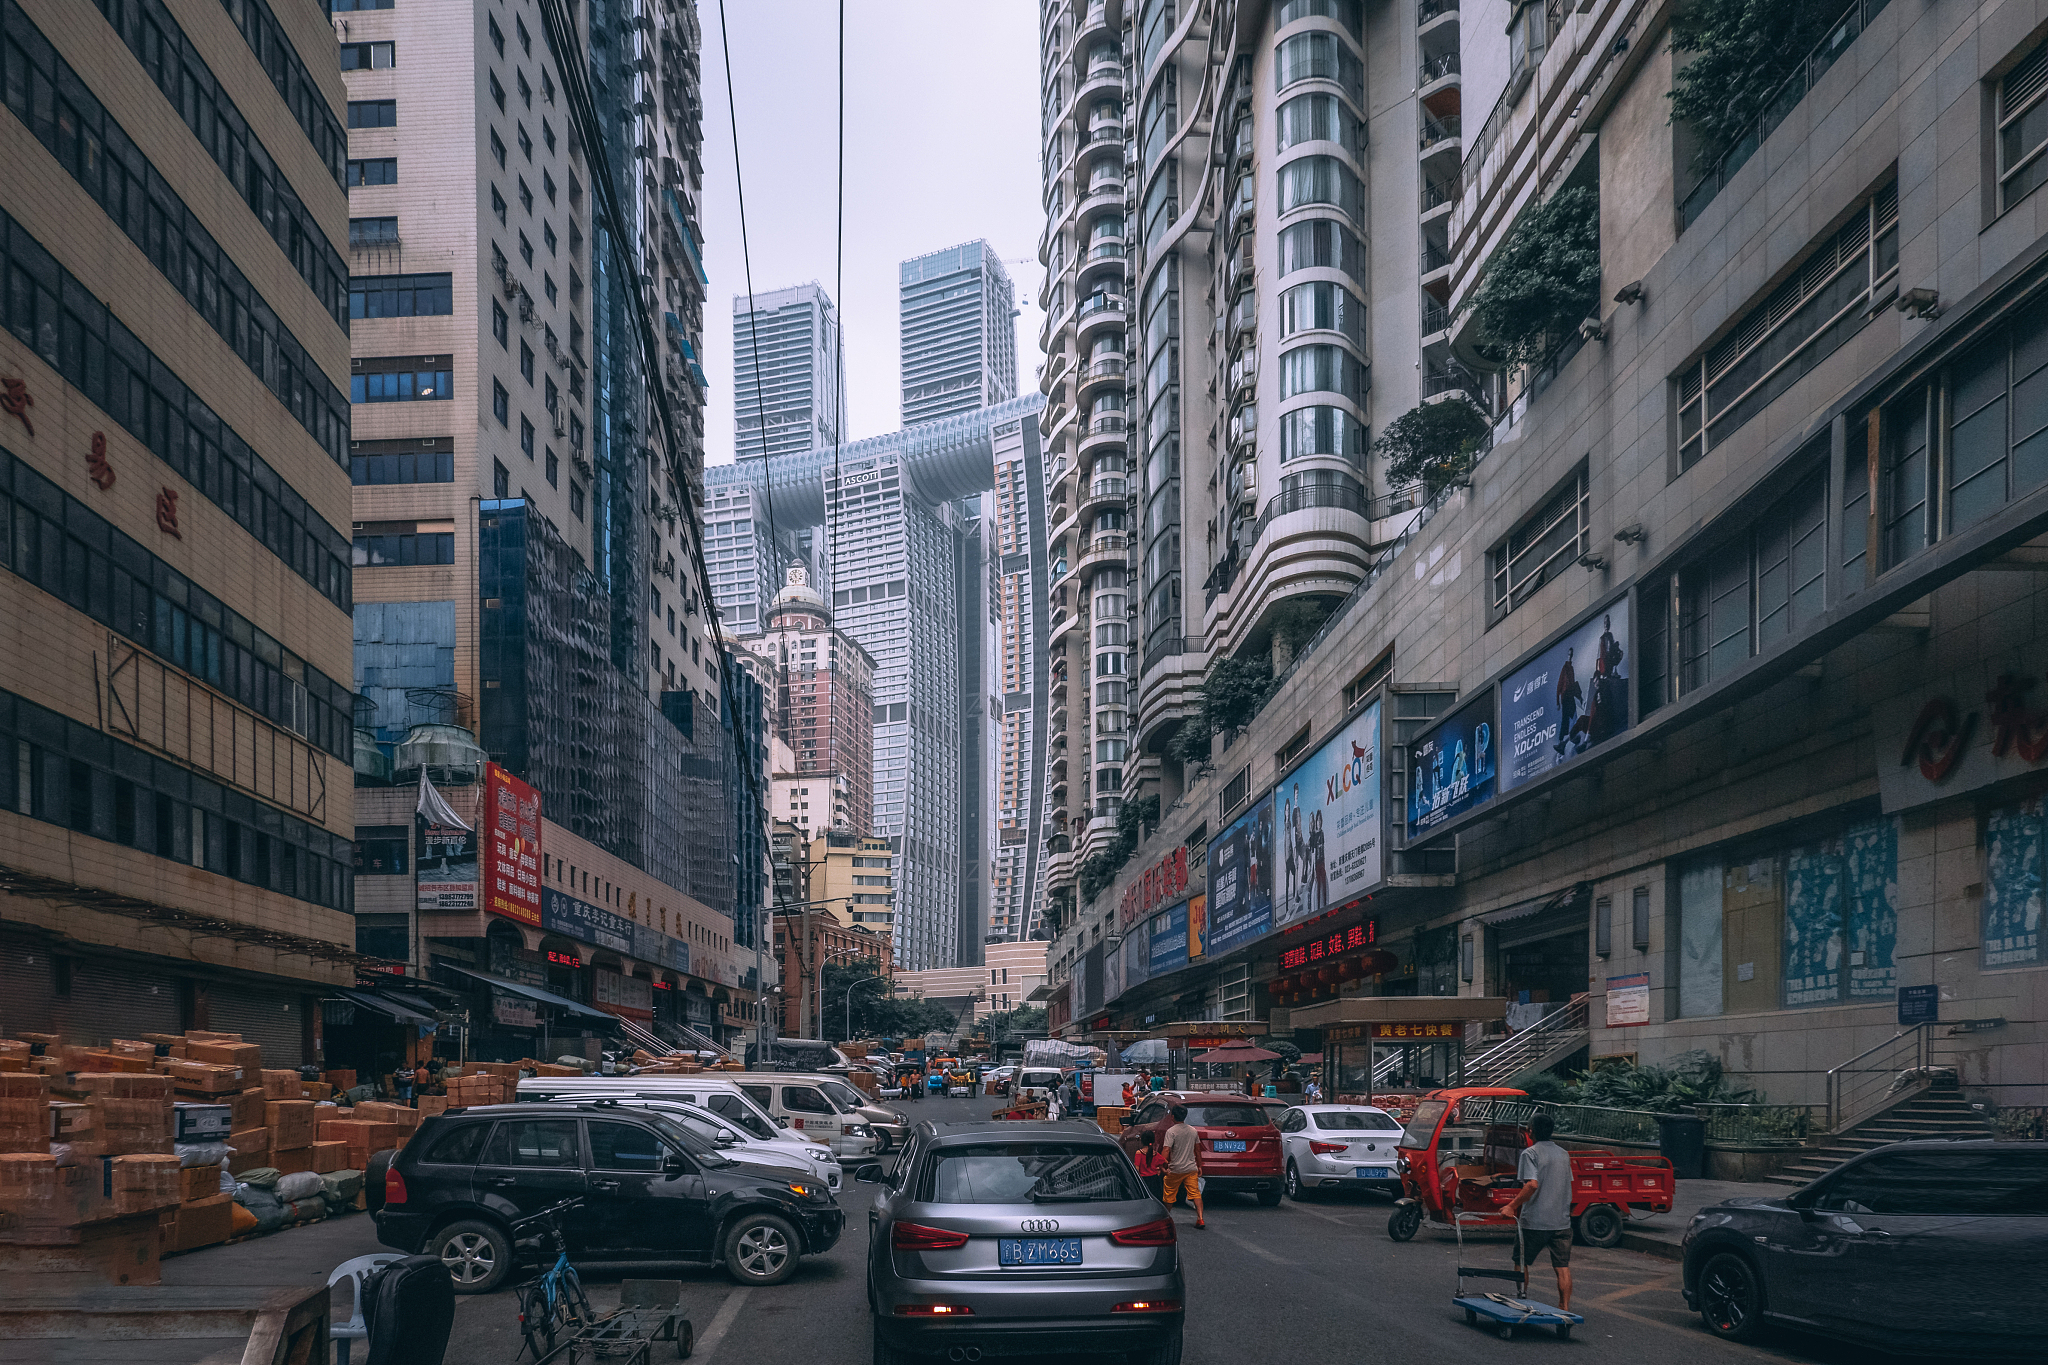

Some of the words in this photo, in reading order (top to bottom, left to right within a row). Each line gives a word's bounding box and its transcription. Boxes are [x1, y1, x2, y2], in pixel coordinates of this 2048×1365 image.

[845, 471, 878, 485] ASCOTT
[1513, 706, 1544, 732] TRANSCEND
[1513, 722, 1537, 743] ENDLESS
[1326, 757, 1362, 806] XLCQ
[572, 900, 632, 936] 重庆李记童车行
[1379, 1024, 1453, 1037] 黄老七快餐
